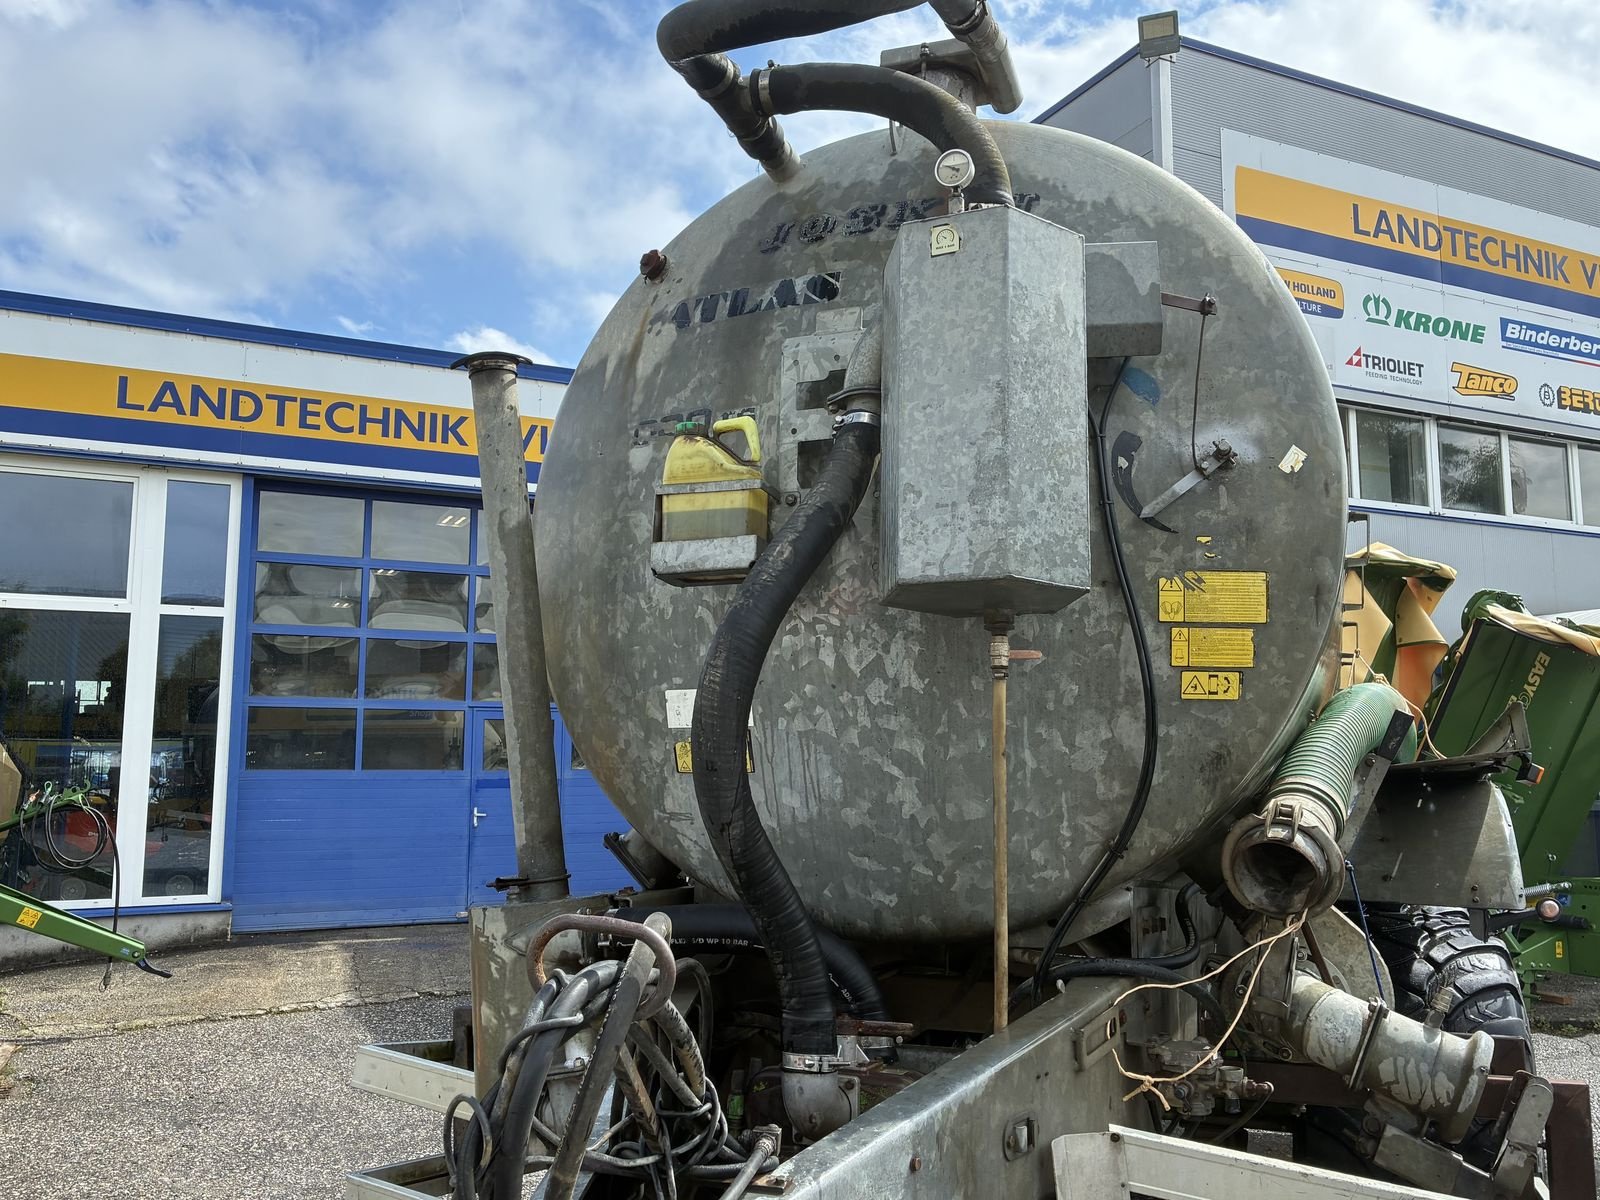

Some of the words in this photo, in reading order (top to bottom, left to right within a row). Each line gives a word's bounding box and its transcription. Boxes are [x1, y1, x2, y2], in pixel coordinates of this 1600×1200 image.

[1352, 203, 1571, 284] LANDTECHNIK
[1579, 259, 1600, 289] V
[1293, 281, 1336, 299] HOLLAND
[1394, 309, 1486, 344] KRONE
[1362, 353, 1424, 377] TRIOLIET
[1366, 371, 1388, 380] FEEDING
[1389, 375, 1423, 385] TECHNOLOGY
[116, 375, 470, 446] LANDTECHNIK
